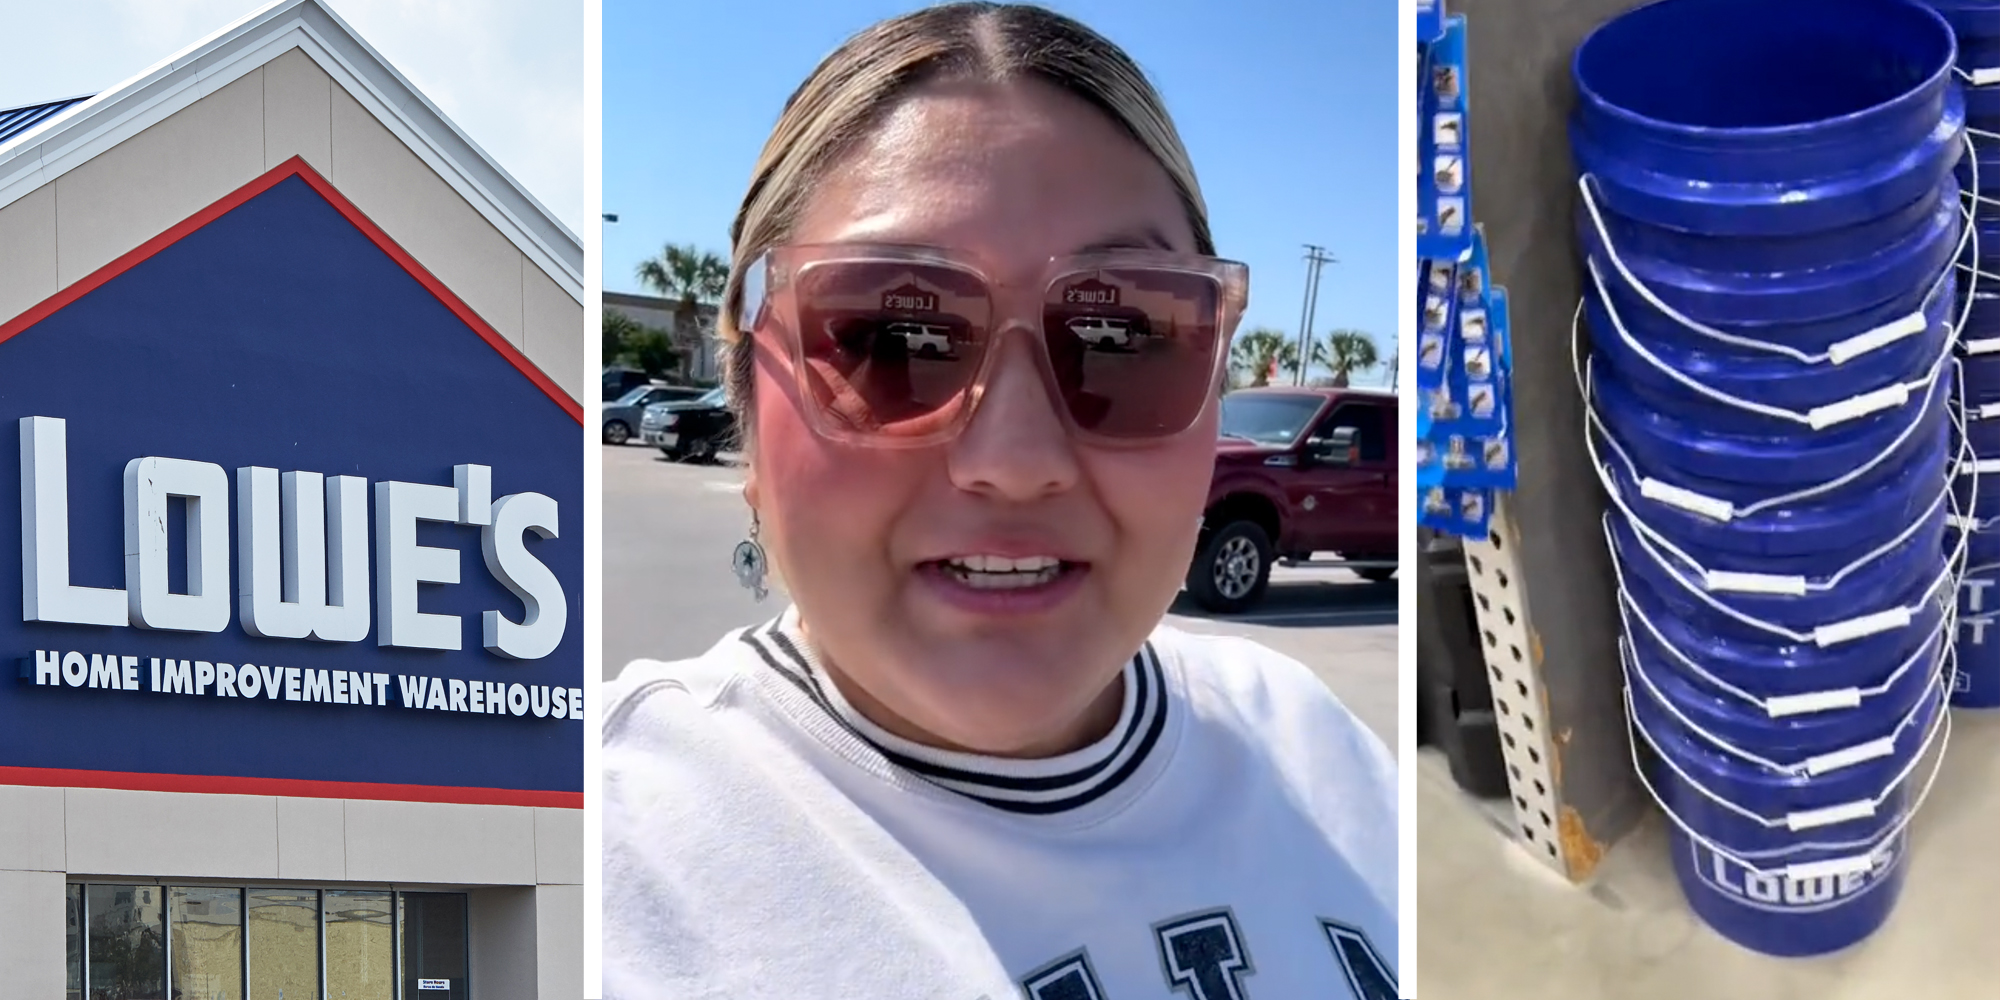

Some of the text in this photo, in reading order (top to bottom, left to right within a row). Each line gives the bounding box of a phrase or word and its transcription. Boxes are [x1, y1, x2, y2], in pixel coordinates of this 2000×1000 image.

[19, 416, 567, 660] LOWE'S
[35, 649, 583, 721] HOME IMPROVEMENT WAREHOUSE
